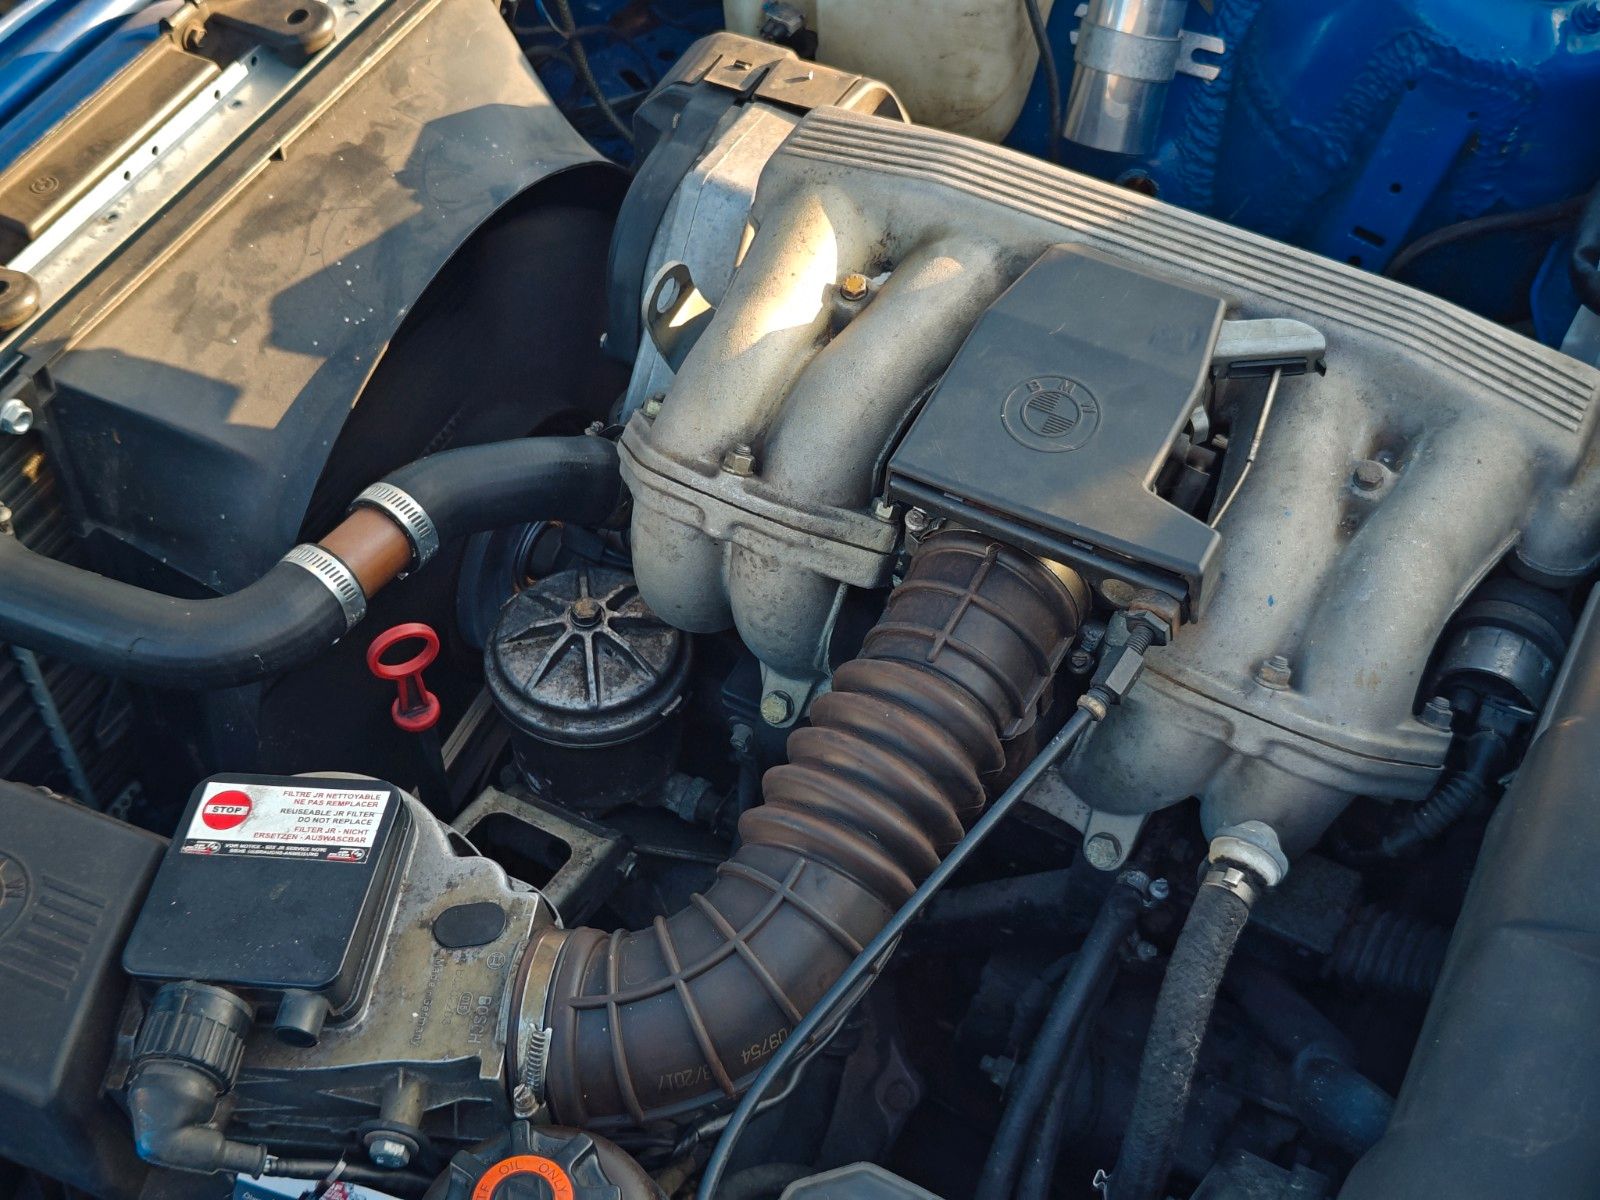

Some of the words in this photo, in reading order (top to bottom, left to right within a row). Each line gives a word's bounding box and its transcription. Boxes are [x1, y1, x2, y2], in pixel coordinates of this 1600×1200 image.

[1026, 379, 1097, 414] BMW
[283, 790, 311, 799] FILTRE
[326, 792, 381, 801] NETTOYABLE
[294, 798, 306, 806] NE
[323, 800, 379, 808] REMPLACER
[212, 805, 243, 814] STOP
[280, 807, 331, 817] REUSEABLE
[332, 810, 345, 818] JR
[346, 810, 376, 818] FILTER
[312, 817, 331, 825] NOT
[333, 818, 373, 826] REPLACE
[294, 826, 324, 834] FILTER
[324, 827, 336, 835] JR
[343, 828, 370, 836] NICHT
[253, 832, 298, 840] ERSETZEN
[306, 834, 367, 844] AUSWASCBAR
[429, 959, 444, 987] Made
[409, 999, 431, 1046] Germany
[468, 996, 491, 1043] BOSCH
[741, 1027, 789, 1065] 09754
[499, 1161, 523, 1175] OIL
[538, 1164, 568, 1192] ONLY
